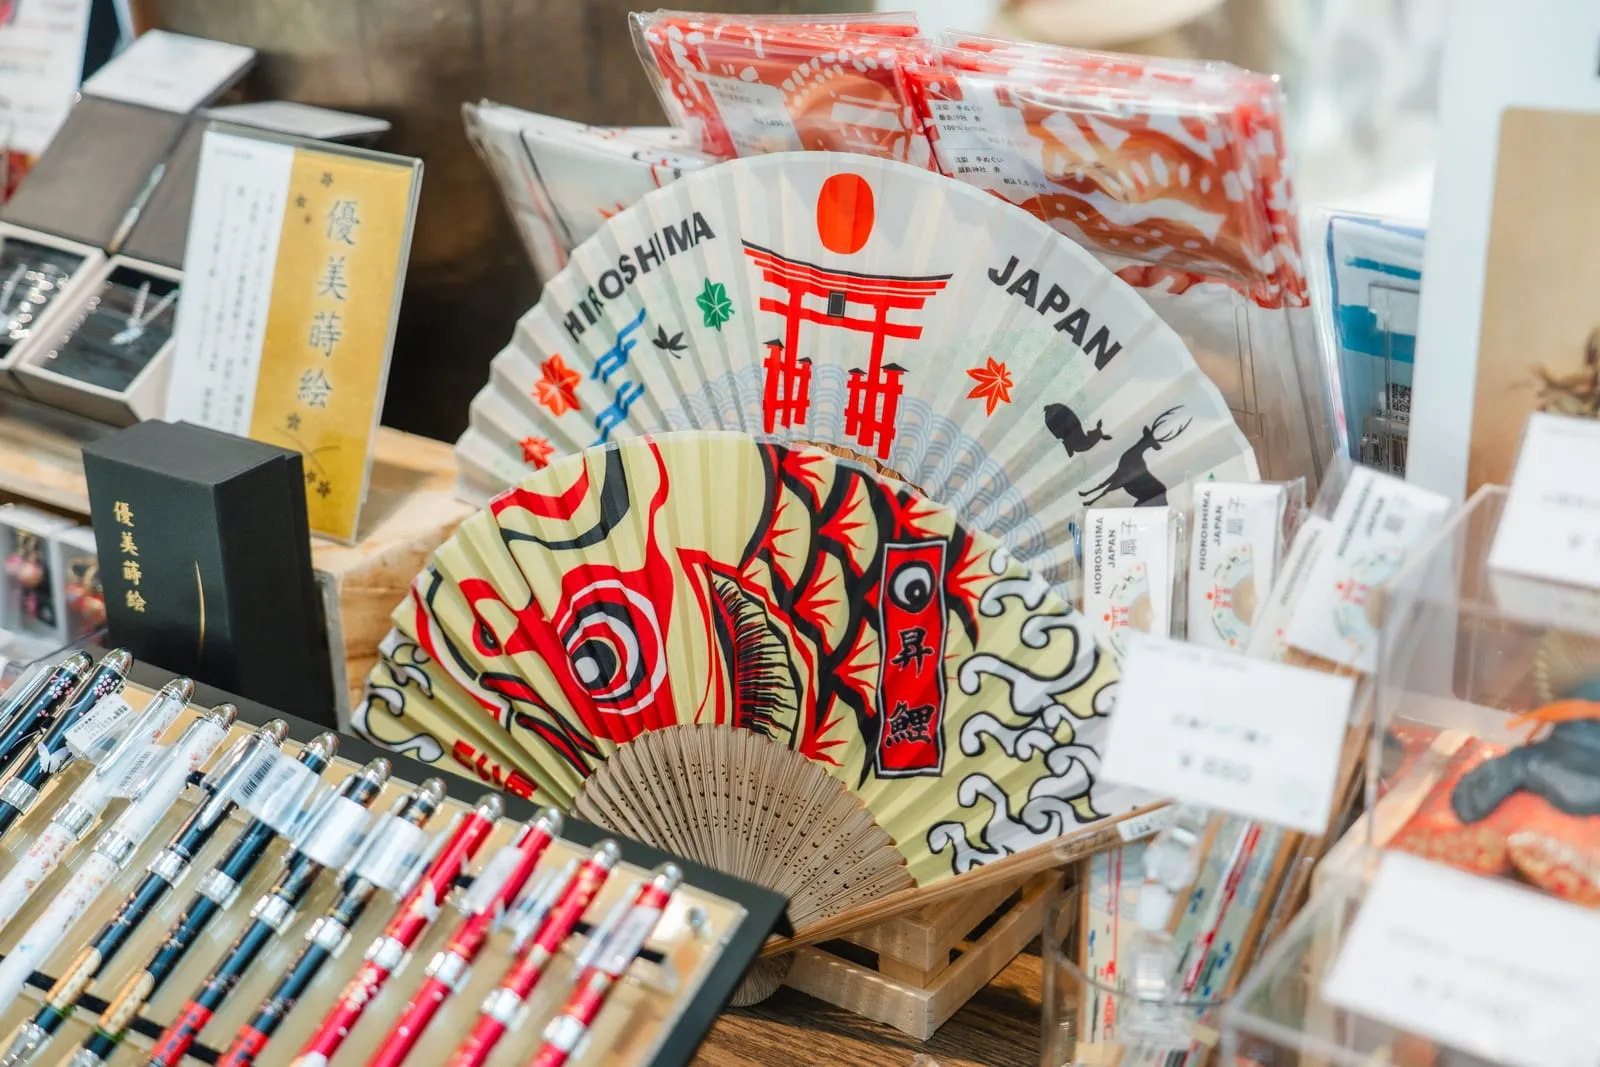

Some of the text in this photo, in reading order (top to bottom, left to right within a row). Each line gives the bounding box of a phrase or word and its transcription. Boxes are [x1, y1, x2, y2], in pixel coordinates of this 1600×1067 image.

[296, 199, 361, 408] 優美蒔絵
[563, 211, 716, 344] HIROSHIMA
[987, 254, 1123, 372] JAPAN
[113, 500, 147, 613] 優美蒔絵
[1094, 516, 1105, 595] HIOROSHIMA
[1106, 529, 1117, 568] JAPAN
[1120, 517, 1138, 557] 扇子
[1212, 504, 1224, 546] JAPAN
[885, 625, 937, 748] 昇鯉
